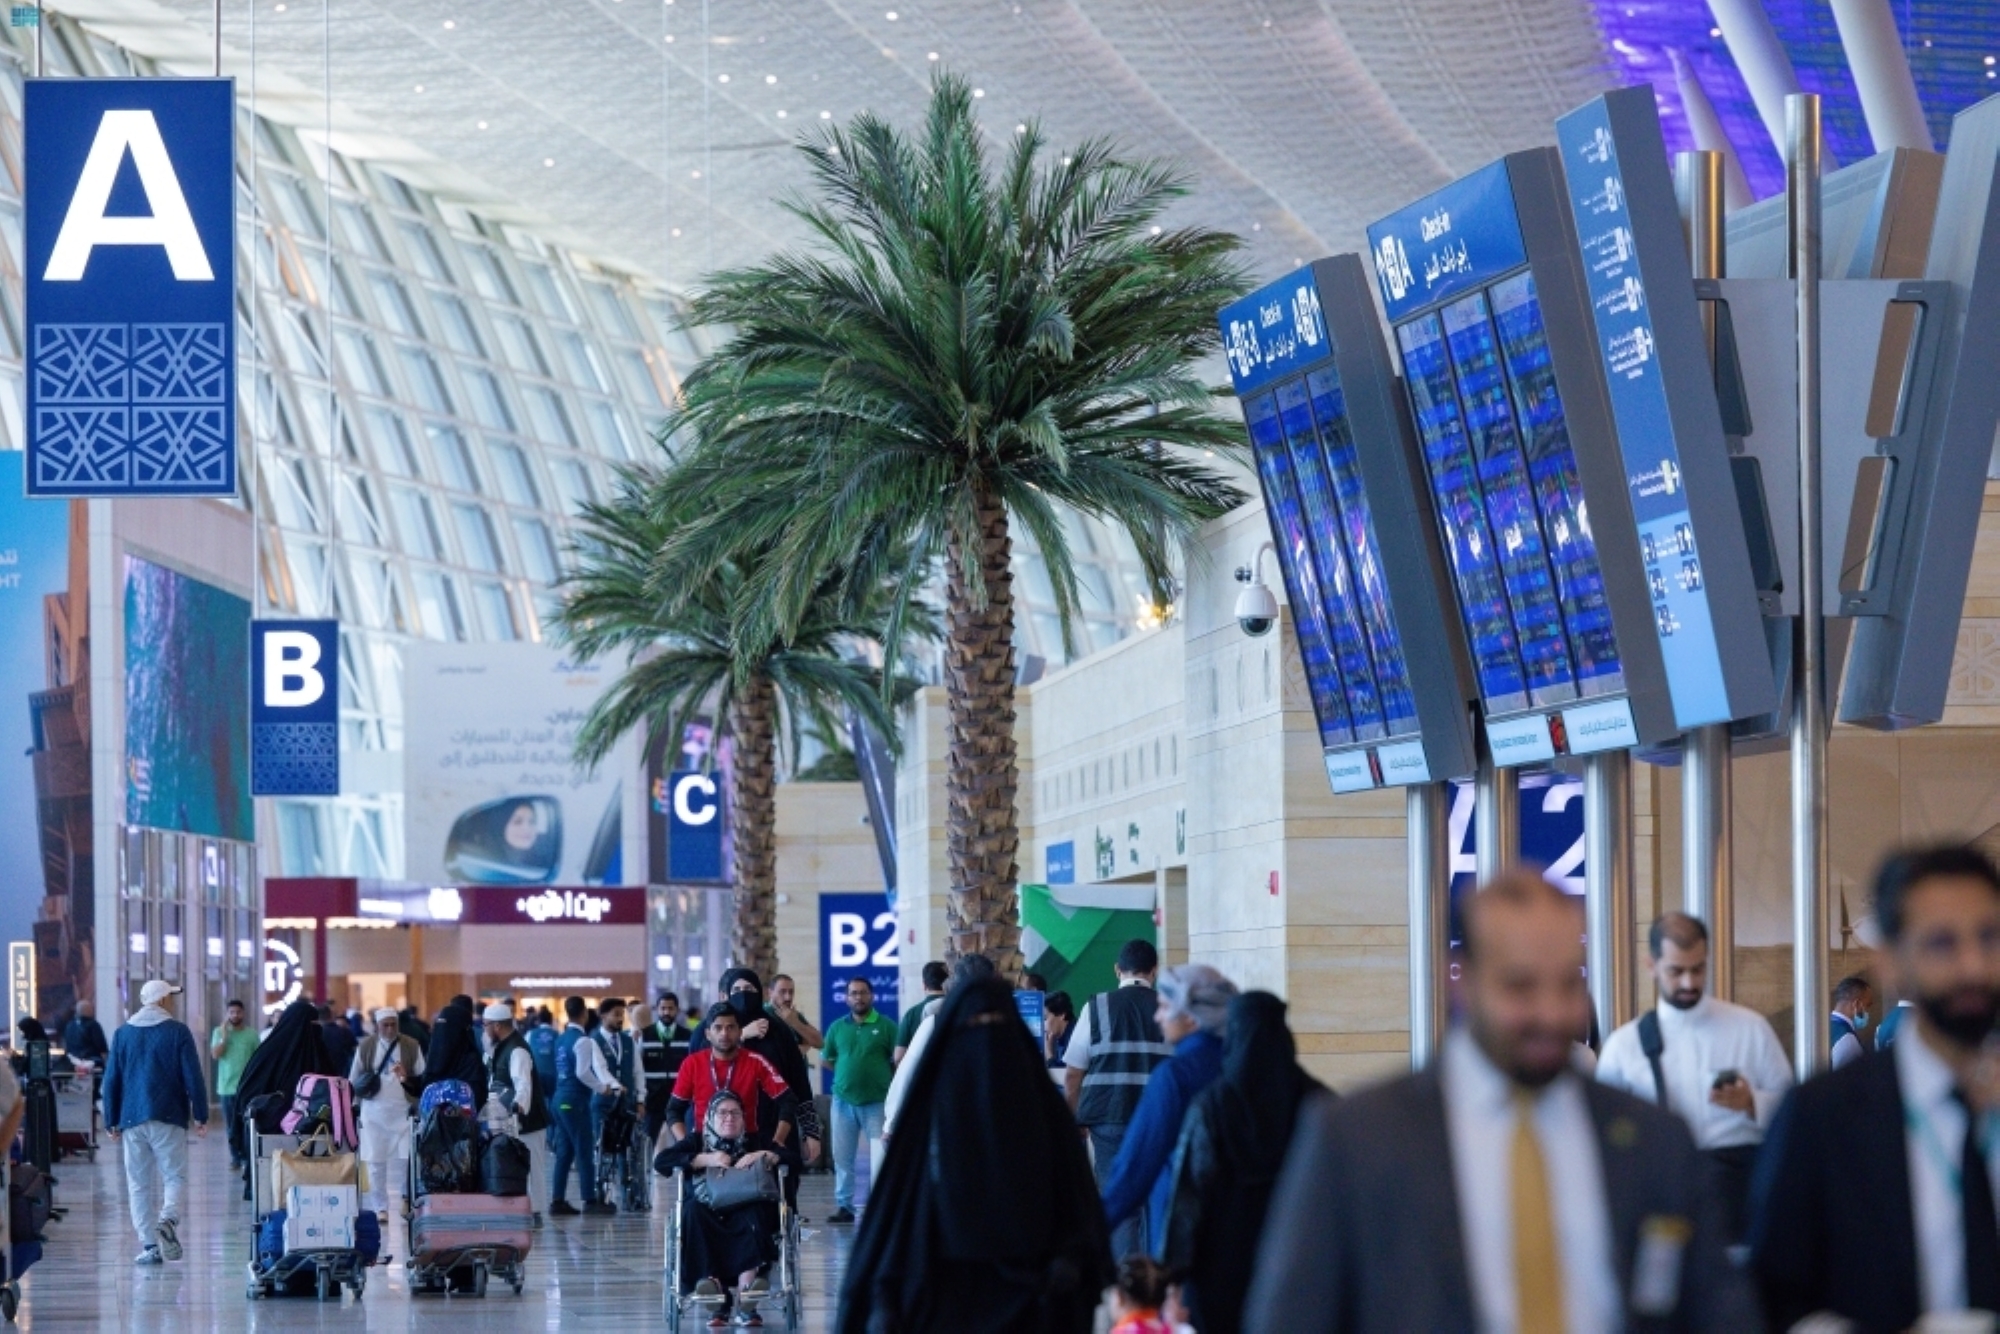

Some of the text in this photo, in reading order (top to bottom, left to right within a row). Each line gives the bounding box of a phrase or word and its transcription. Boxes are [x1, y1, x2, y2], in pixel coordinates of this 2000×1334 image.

[43, 109, 215, 282] A
[264, 630, 325, 707] B
[674, 774, 717, 825] C
[829, 912, 899, 967] B2
